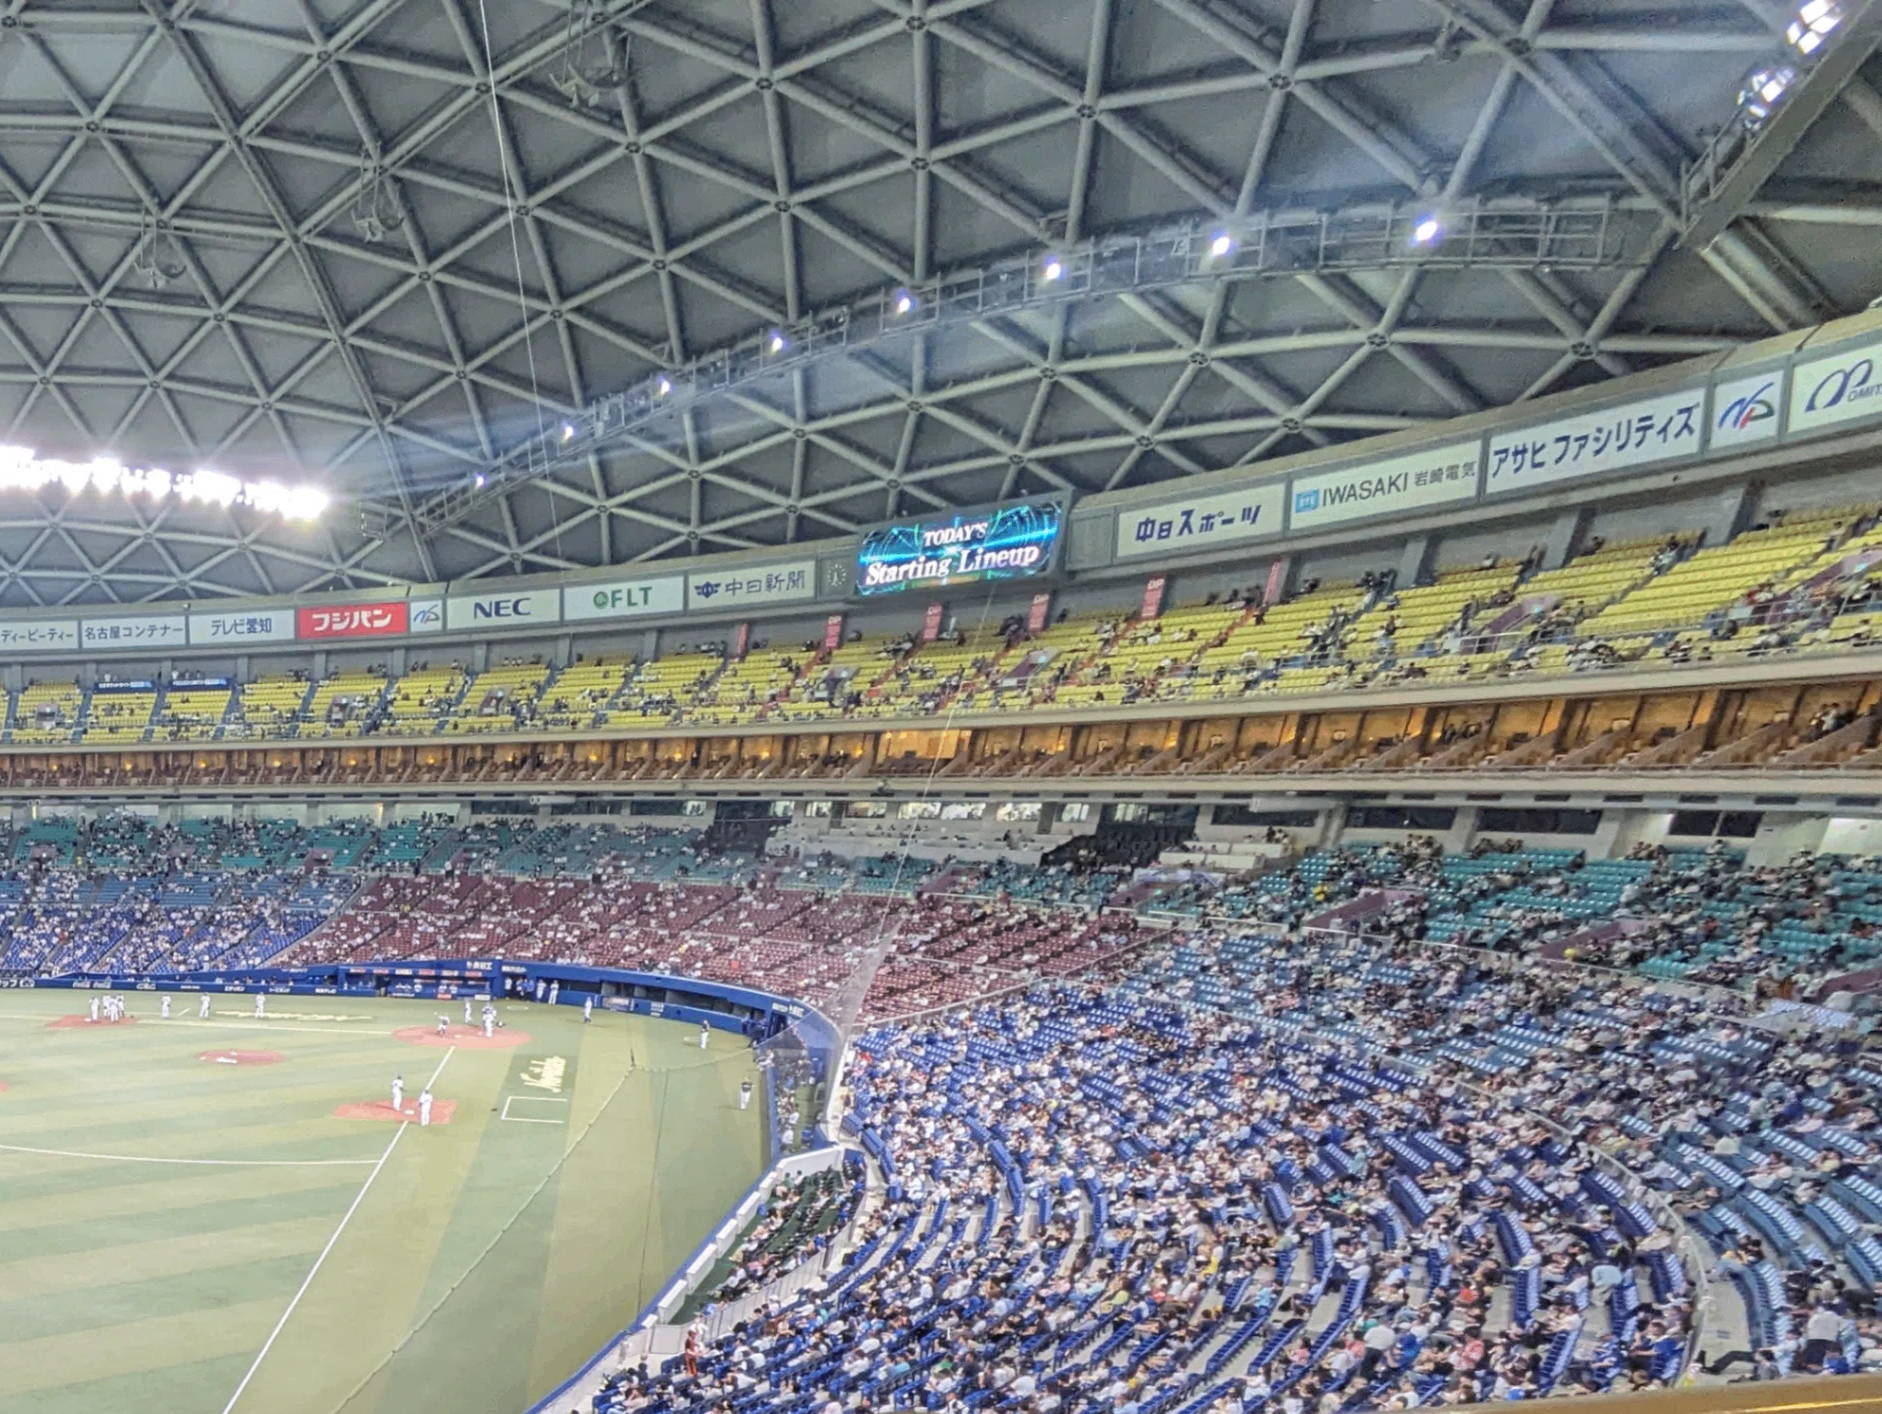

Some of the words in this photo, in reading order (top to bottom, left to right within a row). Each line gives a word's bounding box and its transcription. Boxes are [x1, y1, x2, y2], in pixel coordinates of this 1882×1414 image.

[1322, 472, 1408, 507] IWASAKI
[1413, 462, 1476, 487] 岩崎電気
[924, 522, 989, 547] TODAY'S
[1135, 504, 1262, 542] 中日スポーツ
[865, 555, 953, 586] Starting
[957, 545, 1040, 573] Lineup
[725, 570, 806, 597] 中日新聞
[312, 610, 392, 632] フジパン
[473, 598, 531, 620] NEC
[84, 624, 184, 640] 名古屋コンテナー
[210, 618, 272, 636] テレビ愛知
